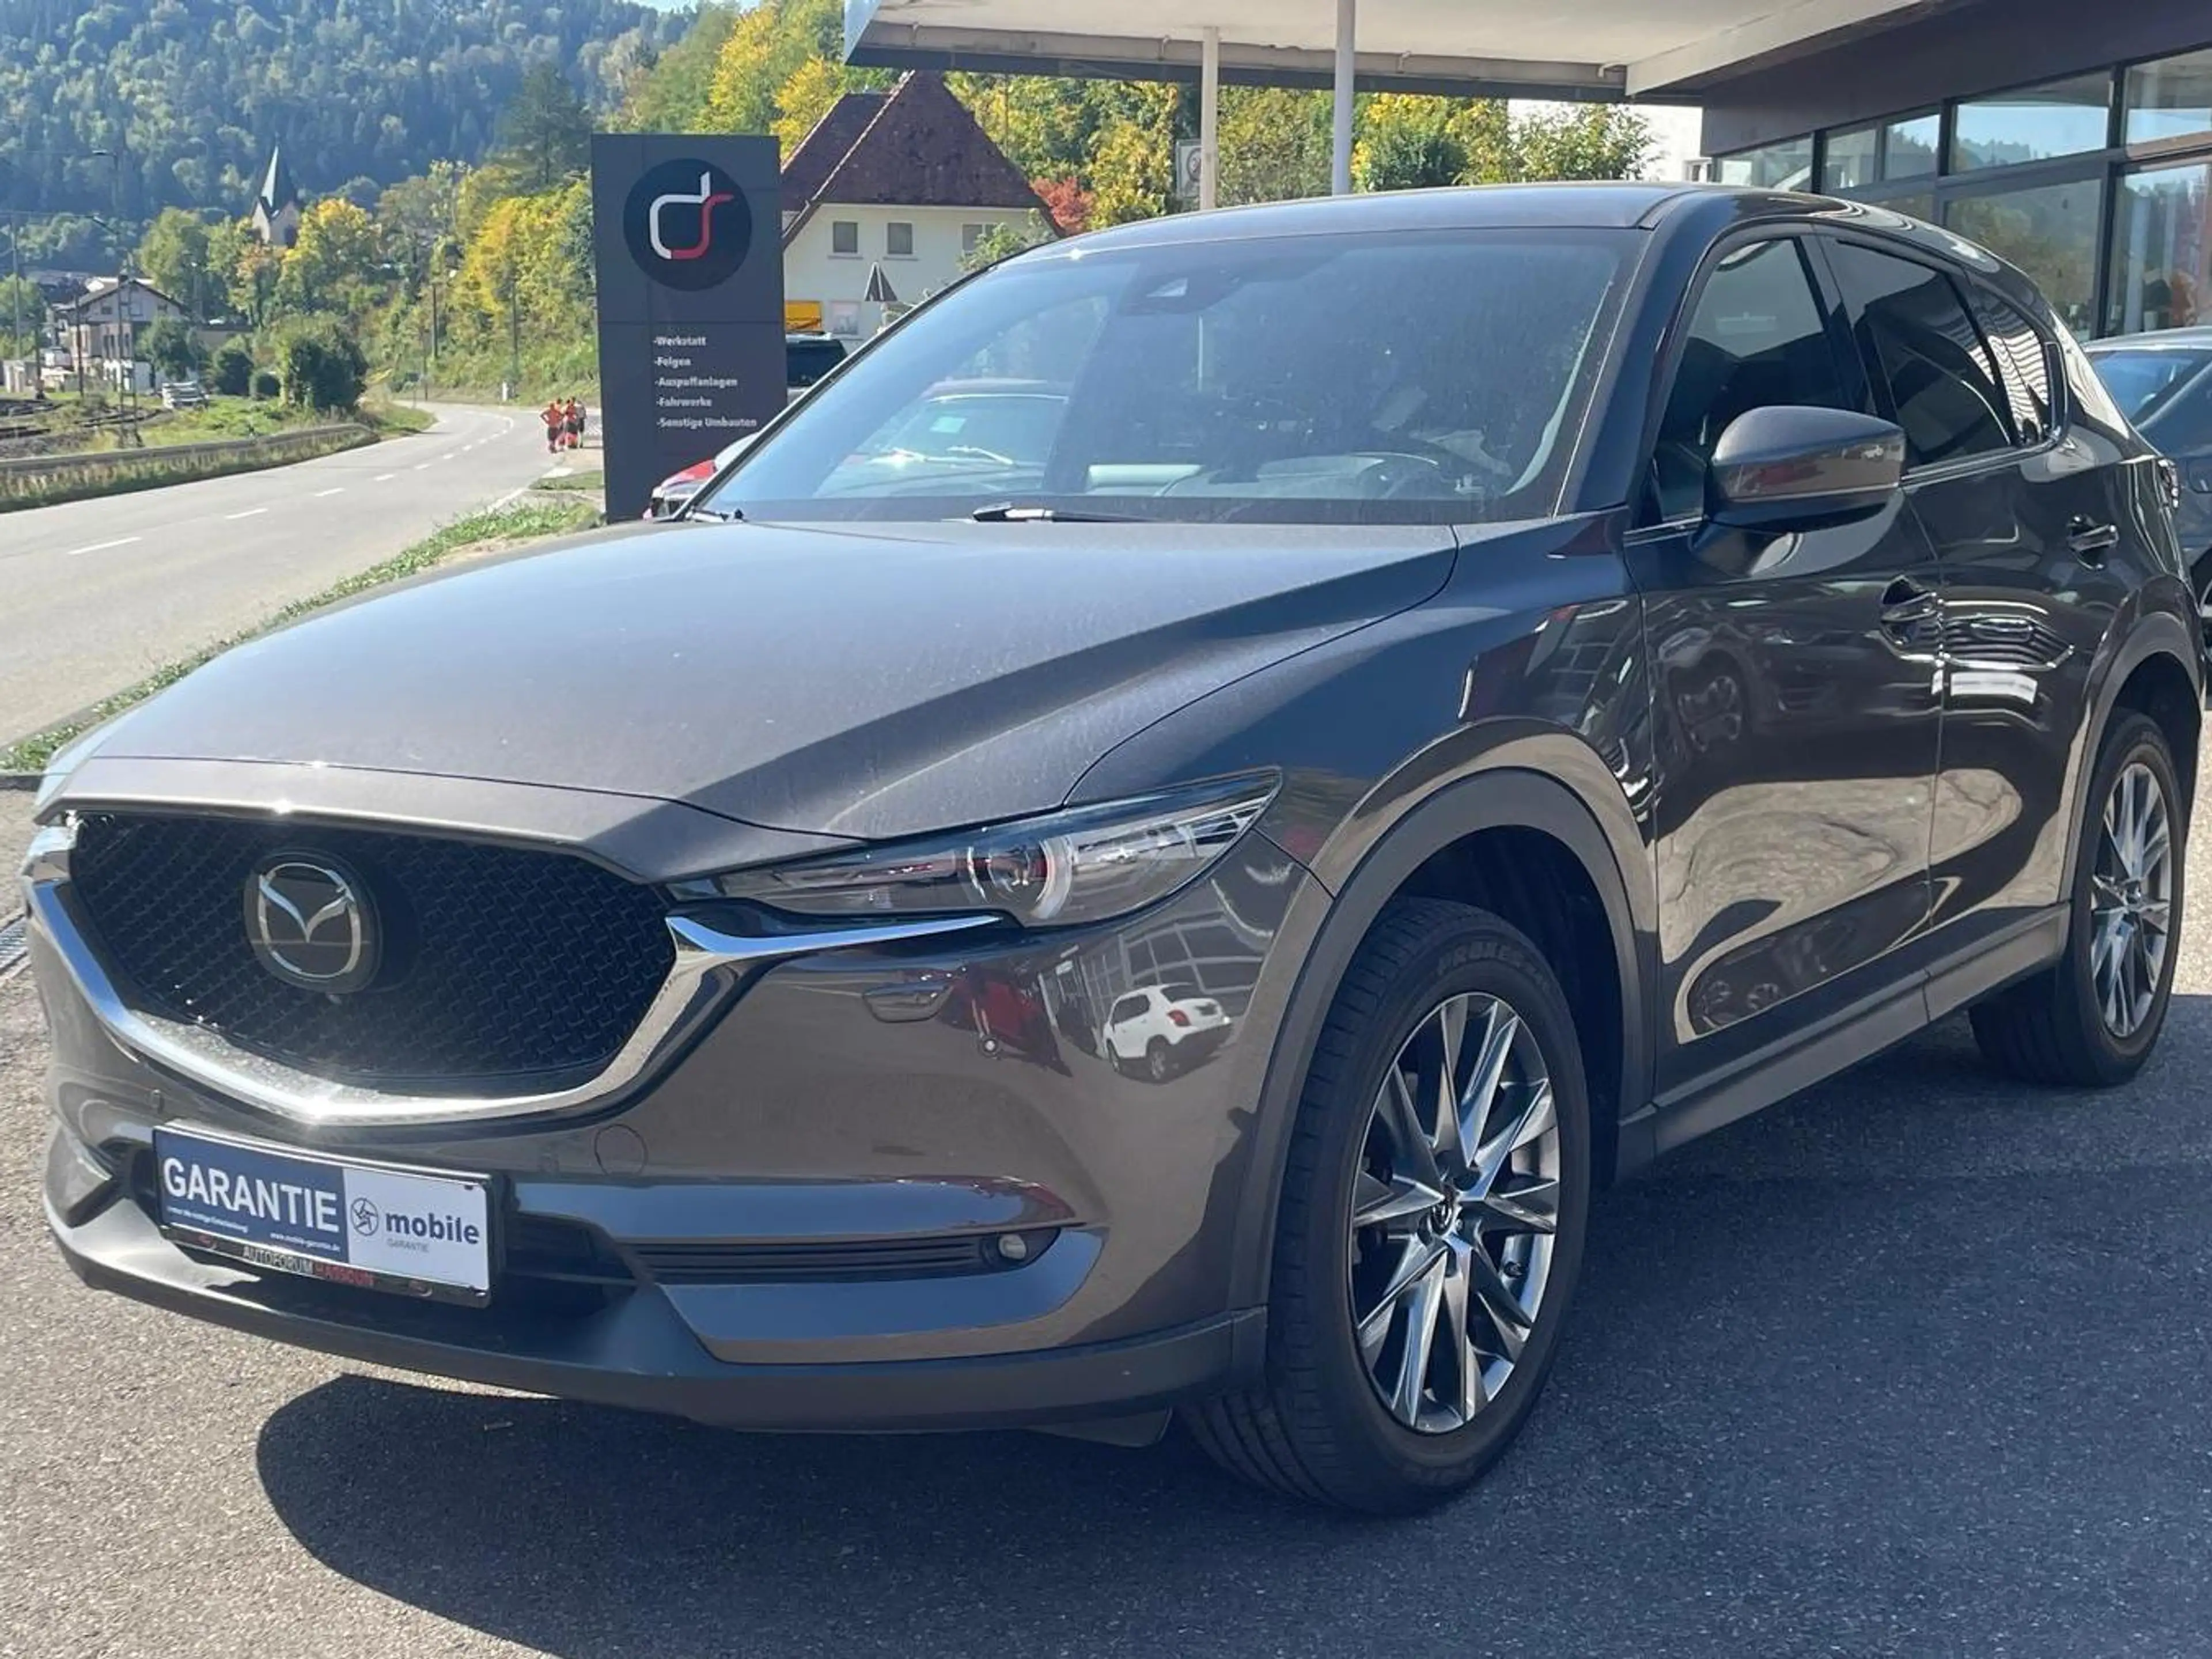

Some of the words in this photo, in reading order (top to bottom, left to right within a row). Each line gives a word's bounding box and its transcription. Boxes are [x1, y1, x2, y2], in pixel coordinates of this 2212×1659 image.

[653, 336, 707, 346] -Werkstatt
[654, 356, 691, 369] -Felgen
[654, 376, 738, 389] -Auspuffanlagen
[656, 396, 712, 407] -Fahrwerke
[704, 415, 757, 427] Umbauten
[163, 1157, 340, 1233] GARANTIE
[385, 1212, 480, 1244] mobile
[387, 1238, 430, 1252] GARANTIE
